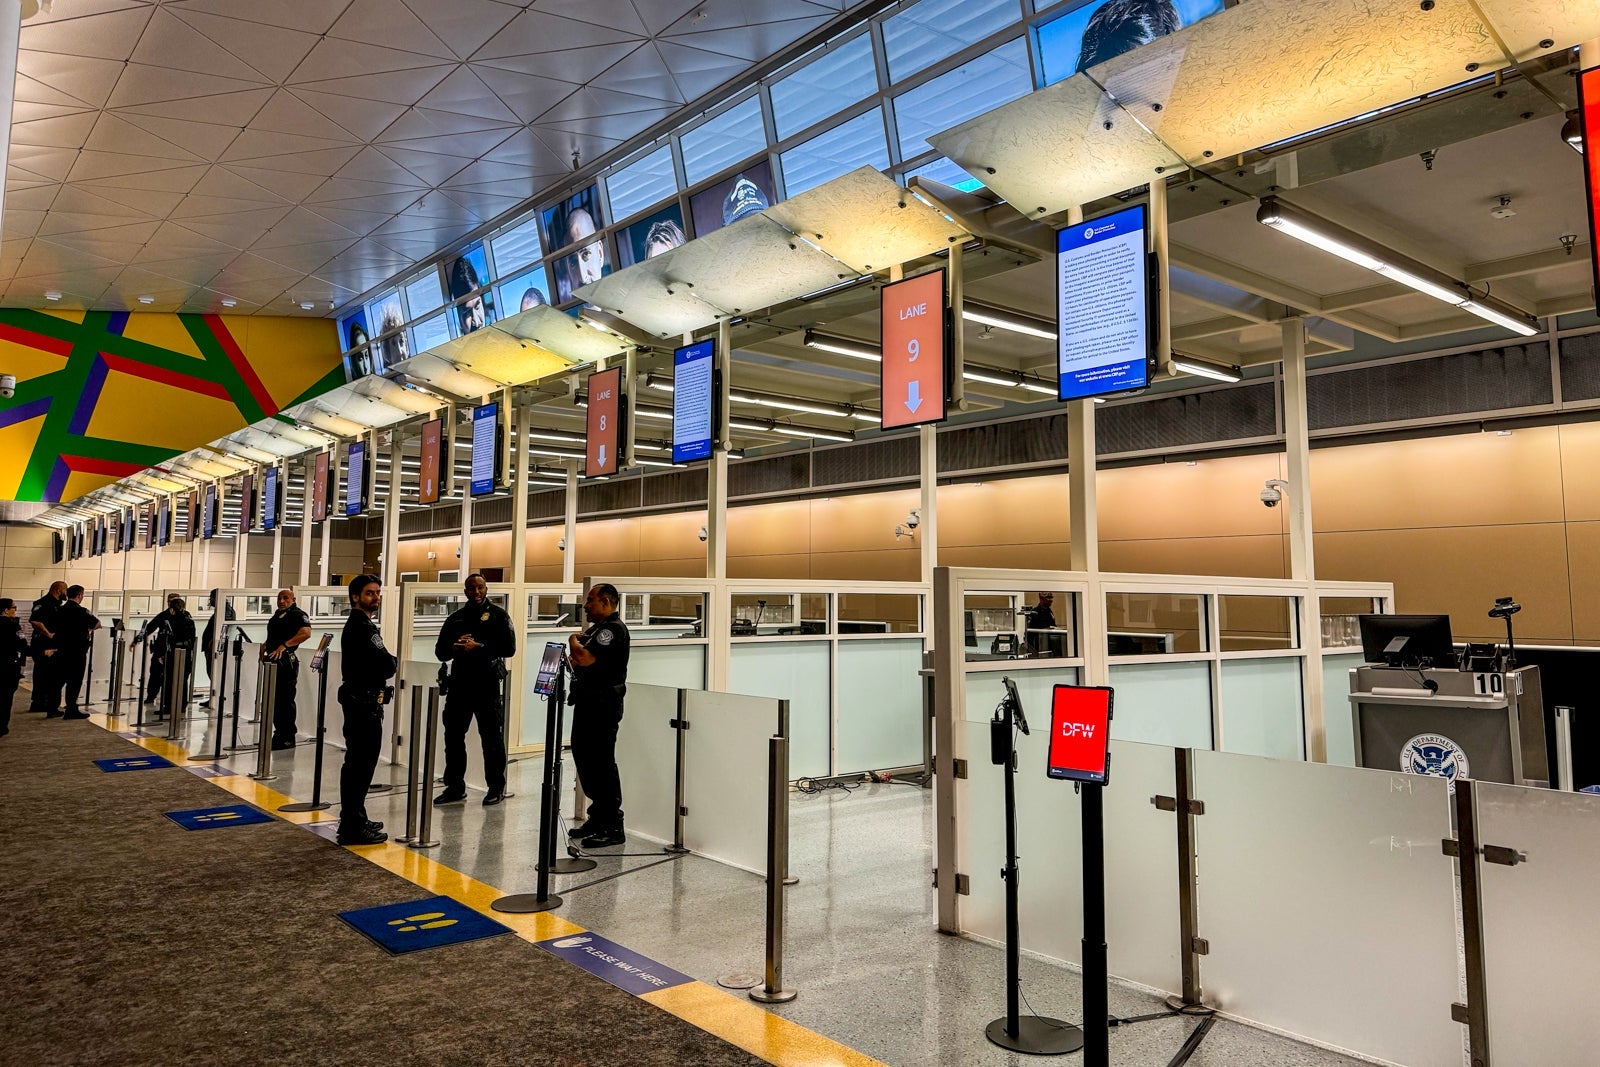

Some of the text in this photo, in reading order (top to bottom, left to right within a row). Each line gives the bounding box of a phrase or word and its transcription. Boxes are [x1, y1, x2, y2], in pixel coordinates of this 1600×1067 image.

[900, 302, 926, 320] LANE
[907, 339, 920, 362] 9
[596, 390, 611, 400] LANE
[600, 415, 606, 430] 8
[428, 456, 433, 468] 7
[1476, 674, 1502, 694] 10
[1062, 722, 1096, 738] DFW
[1412, 736, 1460, 754] DEPARTMENT
[1456, 754, 1464, 762] OF
[582, 946, 668, 986] PLEASE WAIT HERE
